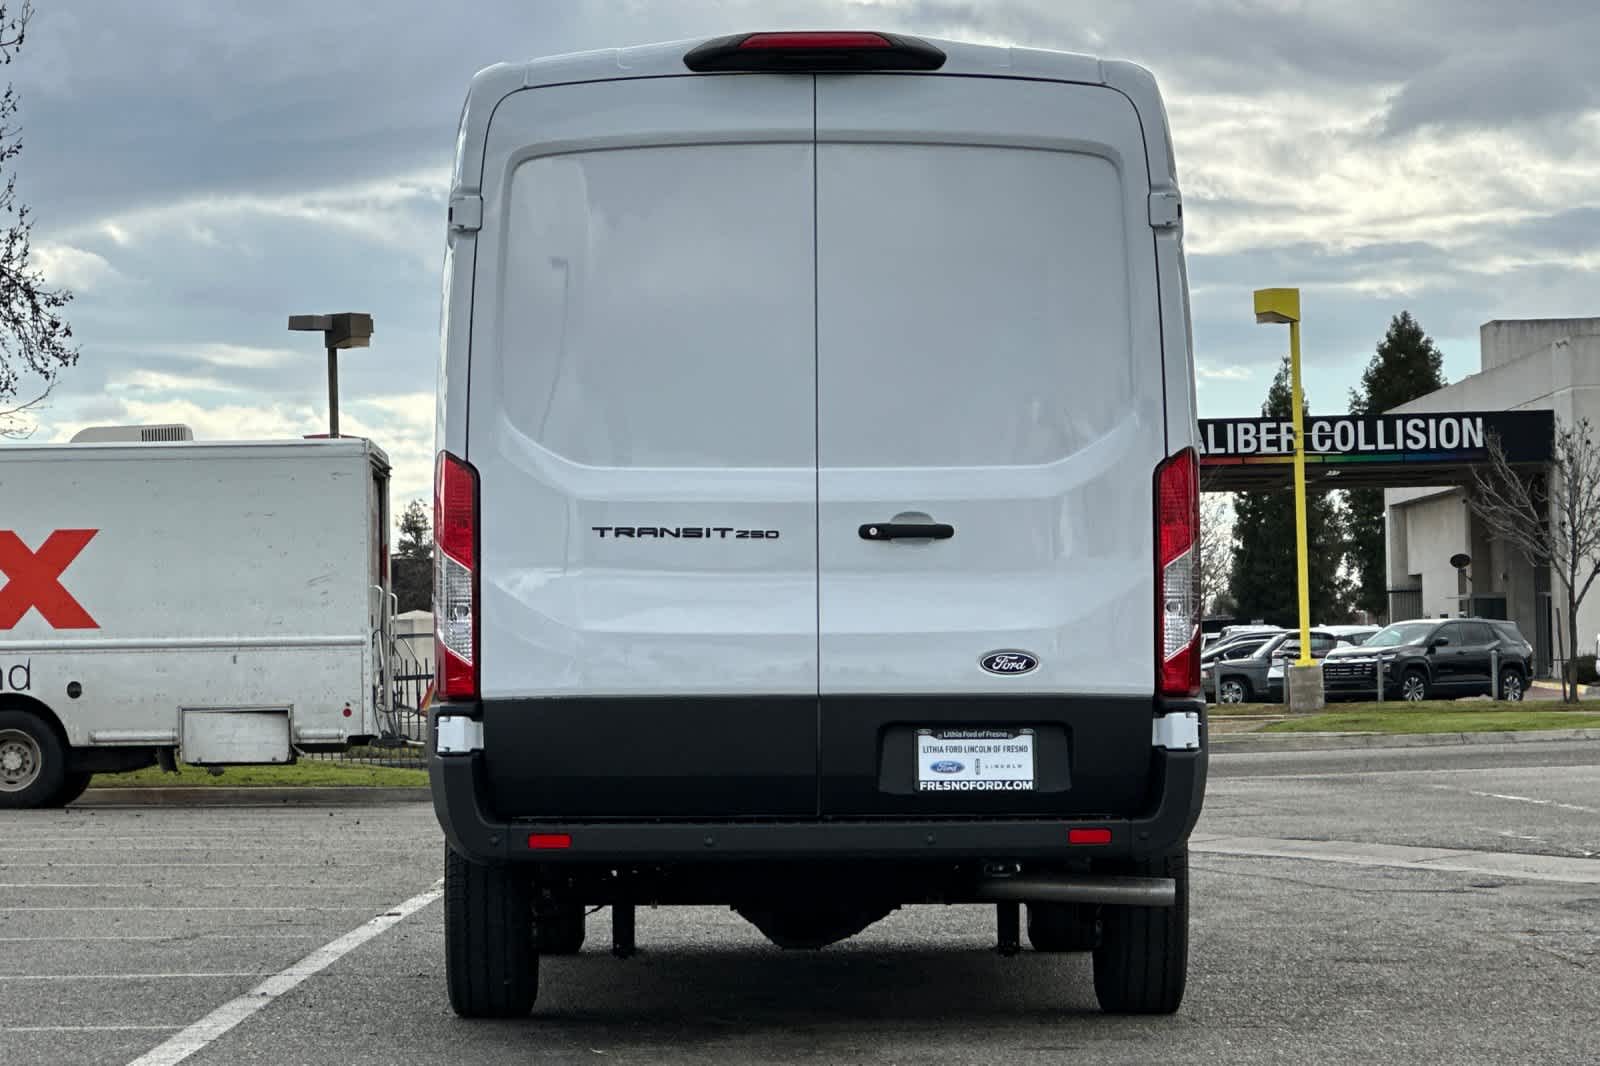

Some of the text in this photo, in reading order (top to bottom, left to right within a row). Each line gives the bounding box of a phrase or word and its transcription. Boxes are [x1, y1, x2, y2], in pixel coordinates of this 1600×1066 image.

[1311, 417, 1484, 451] COLLISION
[592, 526, 780, 539] TRANSIT 250
[992, 655, 1027, 670] Ford
[923, 744, 1029, 754] LITHIA FORD LINCOLN OF FRESNO
[920, 781, 1033, 790] FRESNOFORD.COM
